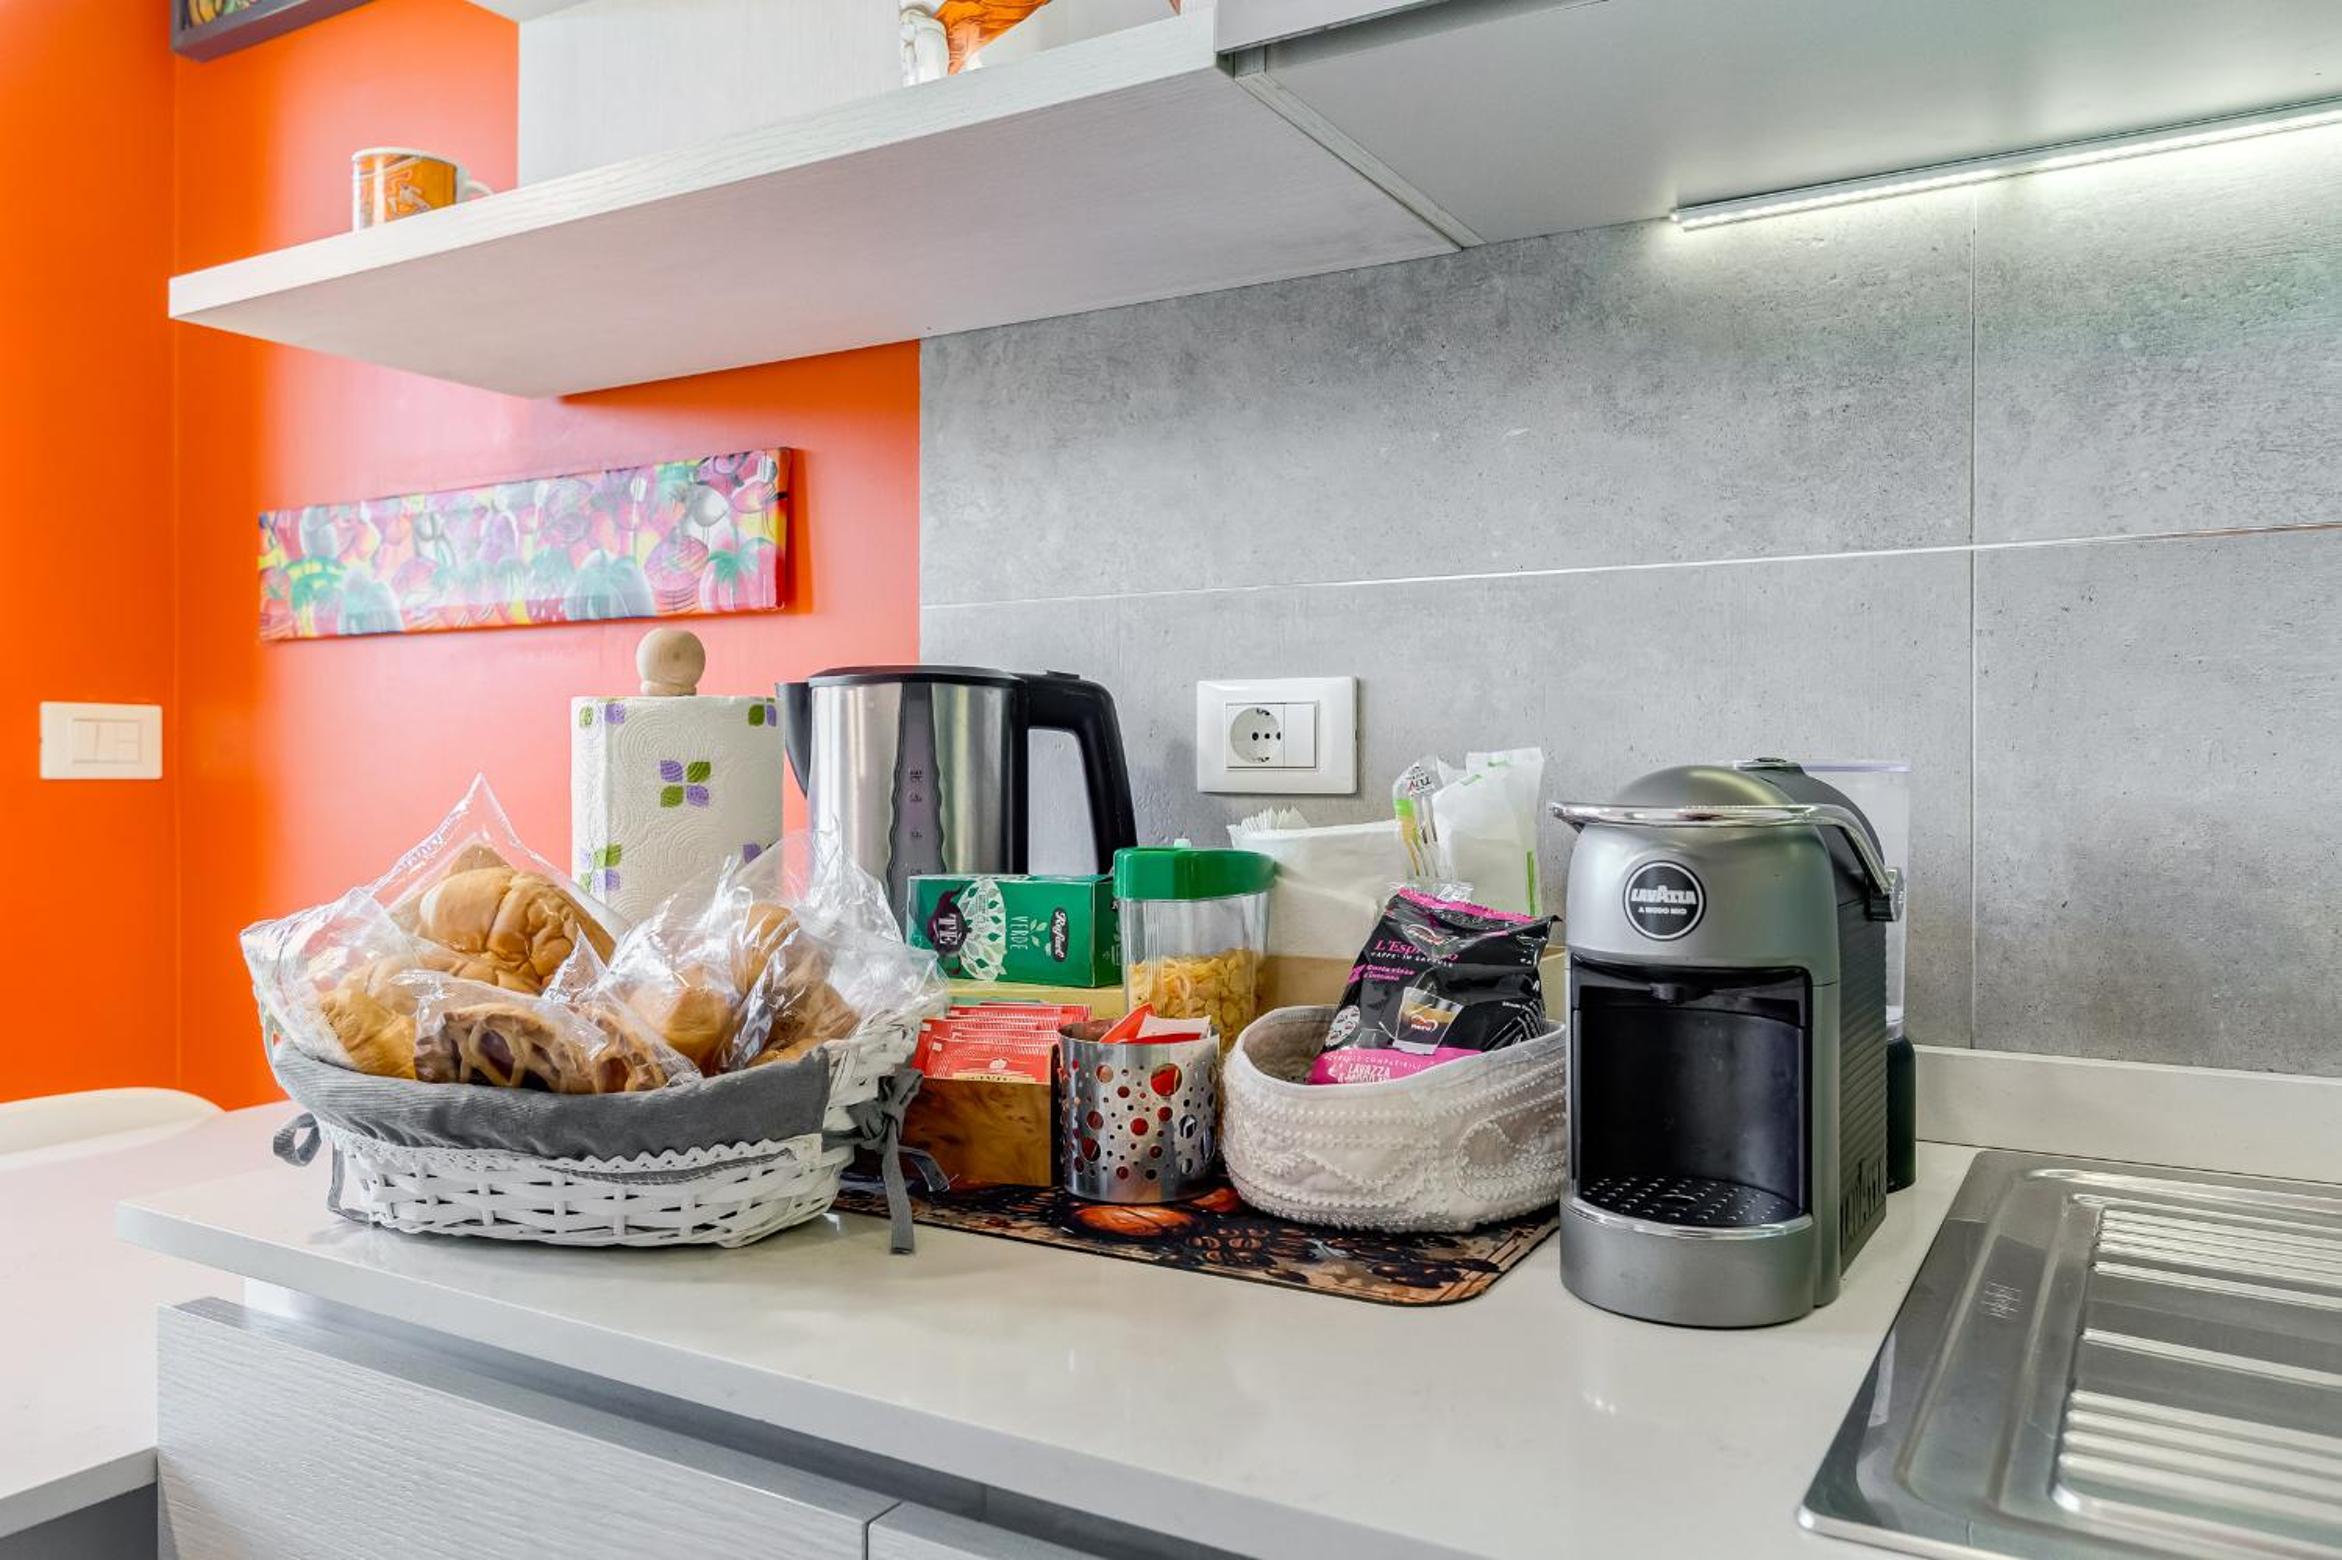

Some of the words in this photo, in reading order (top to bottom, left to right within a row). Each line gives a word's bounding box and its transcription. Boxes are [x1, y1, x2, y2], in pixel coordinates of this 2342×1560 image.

[1630, 884, 1697, 905] LAVAZZA
[938, 913, 961, 945] TÈ
[1009, 916, 1029, 950] VERDE
